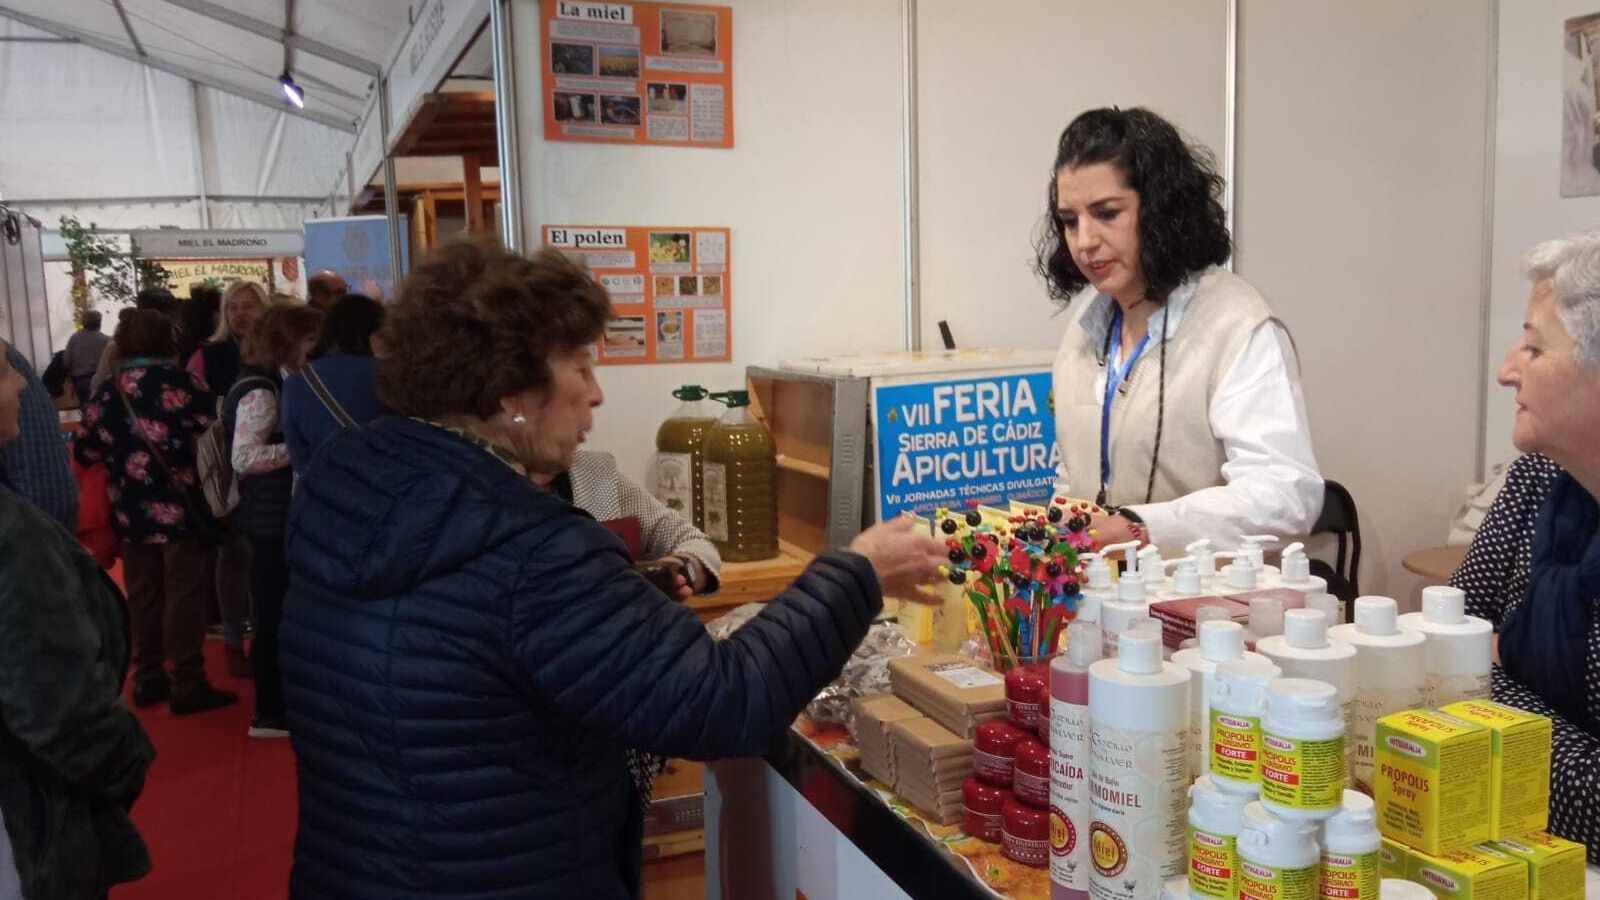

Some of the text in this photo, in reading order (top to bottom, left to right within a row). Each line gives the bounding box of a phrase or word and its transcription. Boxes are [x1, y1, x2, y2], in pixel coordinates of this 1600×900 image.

[560, 3, 626, 20] La miel
[551, 230, 624, 248] El polen
[194, 265, 208, 276] EL
[901, 378, 1037, 428] VII FERIA
[899, 419, 1043, 452] SIERRA DE CÁDIZ
[892, 441, 1063, 487] APICULTURA
[903, 488, 956, 504] JORNADAS
[959, 482, 1005, 496] TÉCNICAS
[1221, 747, 1248, 760] FORTE
[1264, 768, 1289, 783] FORTE
[1380, 763, 1430, 793] PROPOLIS
[1392, 780, 1416, 803] Spray
[1196, 863, 1221, 876] FORTE
